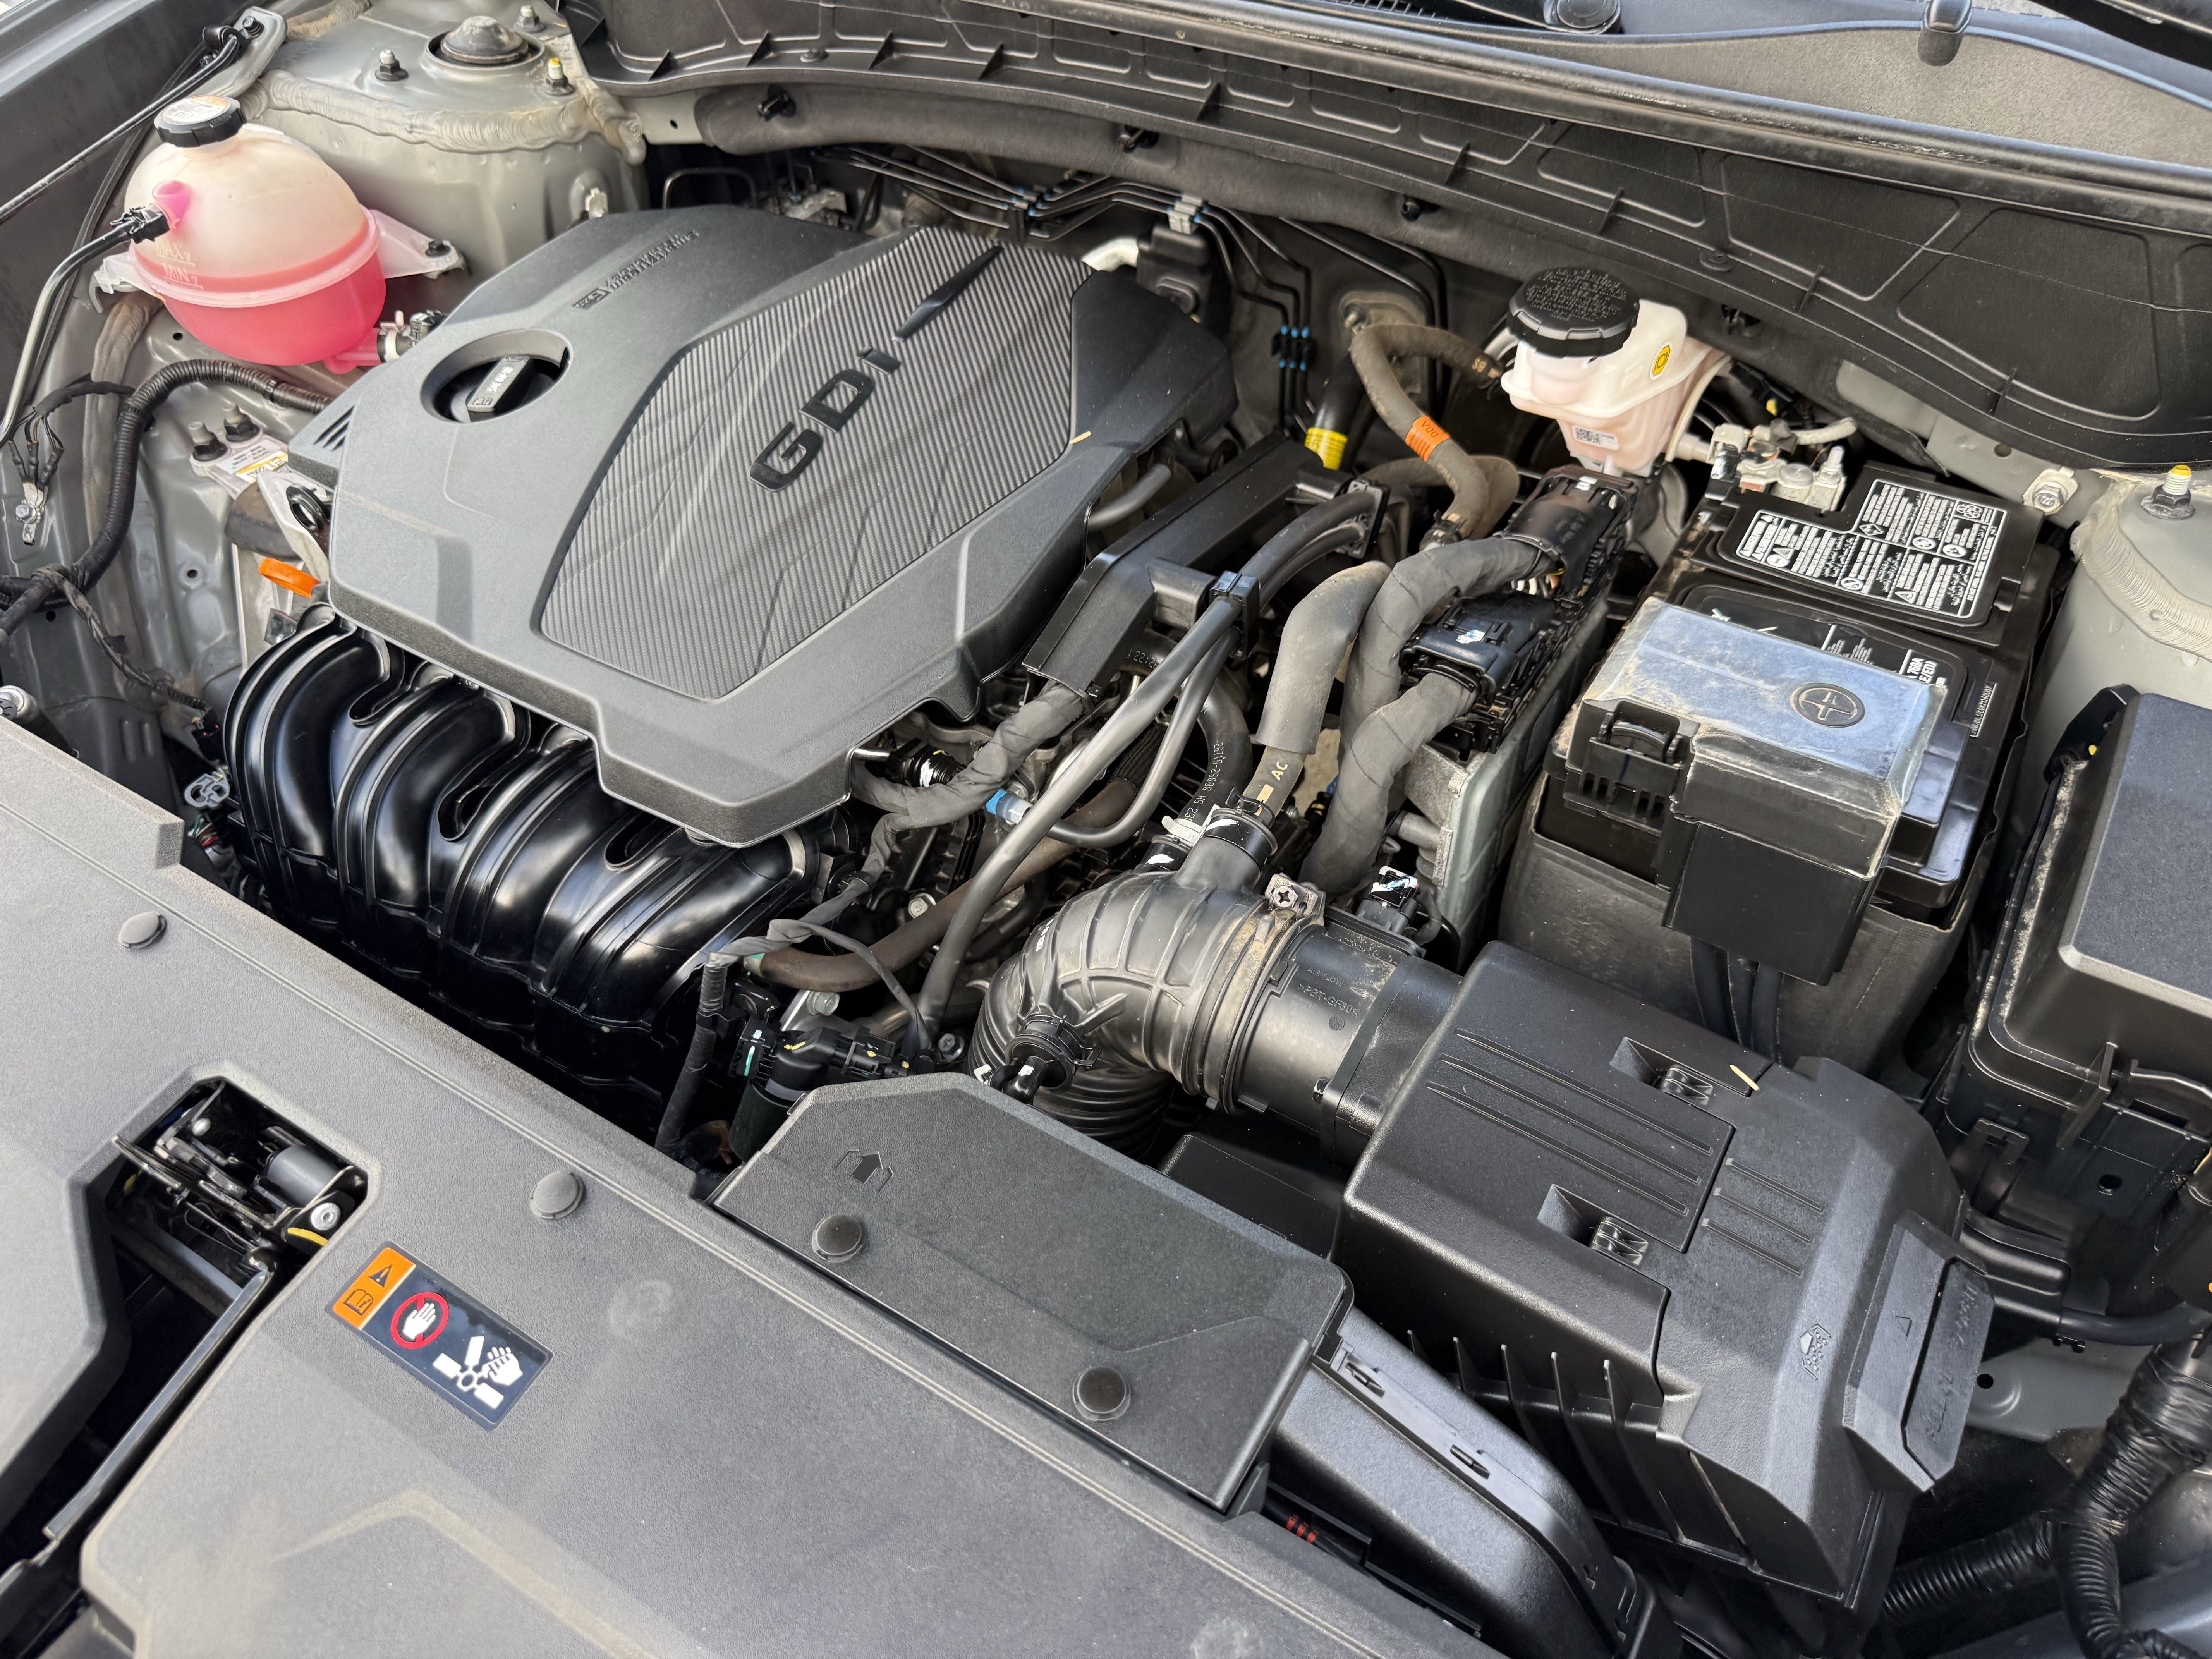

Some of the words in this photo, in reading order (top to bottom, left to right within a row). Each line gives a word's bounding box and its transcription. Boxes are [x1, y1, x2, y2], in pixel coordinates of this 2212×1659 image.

[155, 238, 184, 260] MAX
[162, 262, 190, 283] MIN
[1907, 658, 1925, 675] 760A
[1271, 761, 1288, 781] AC
